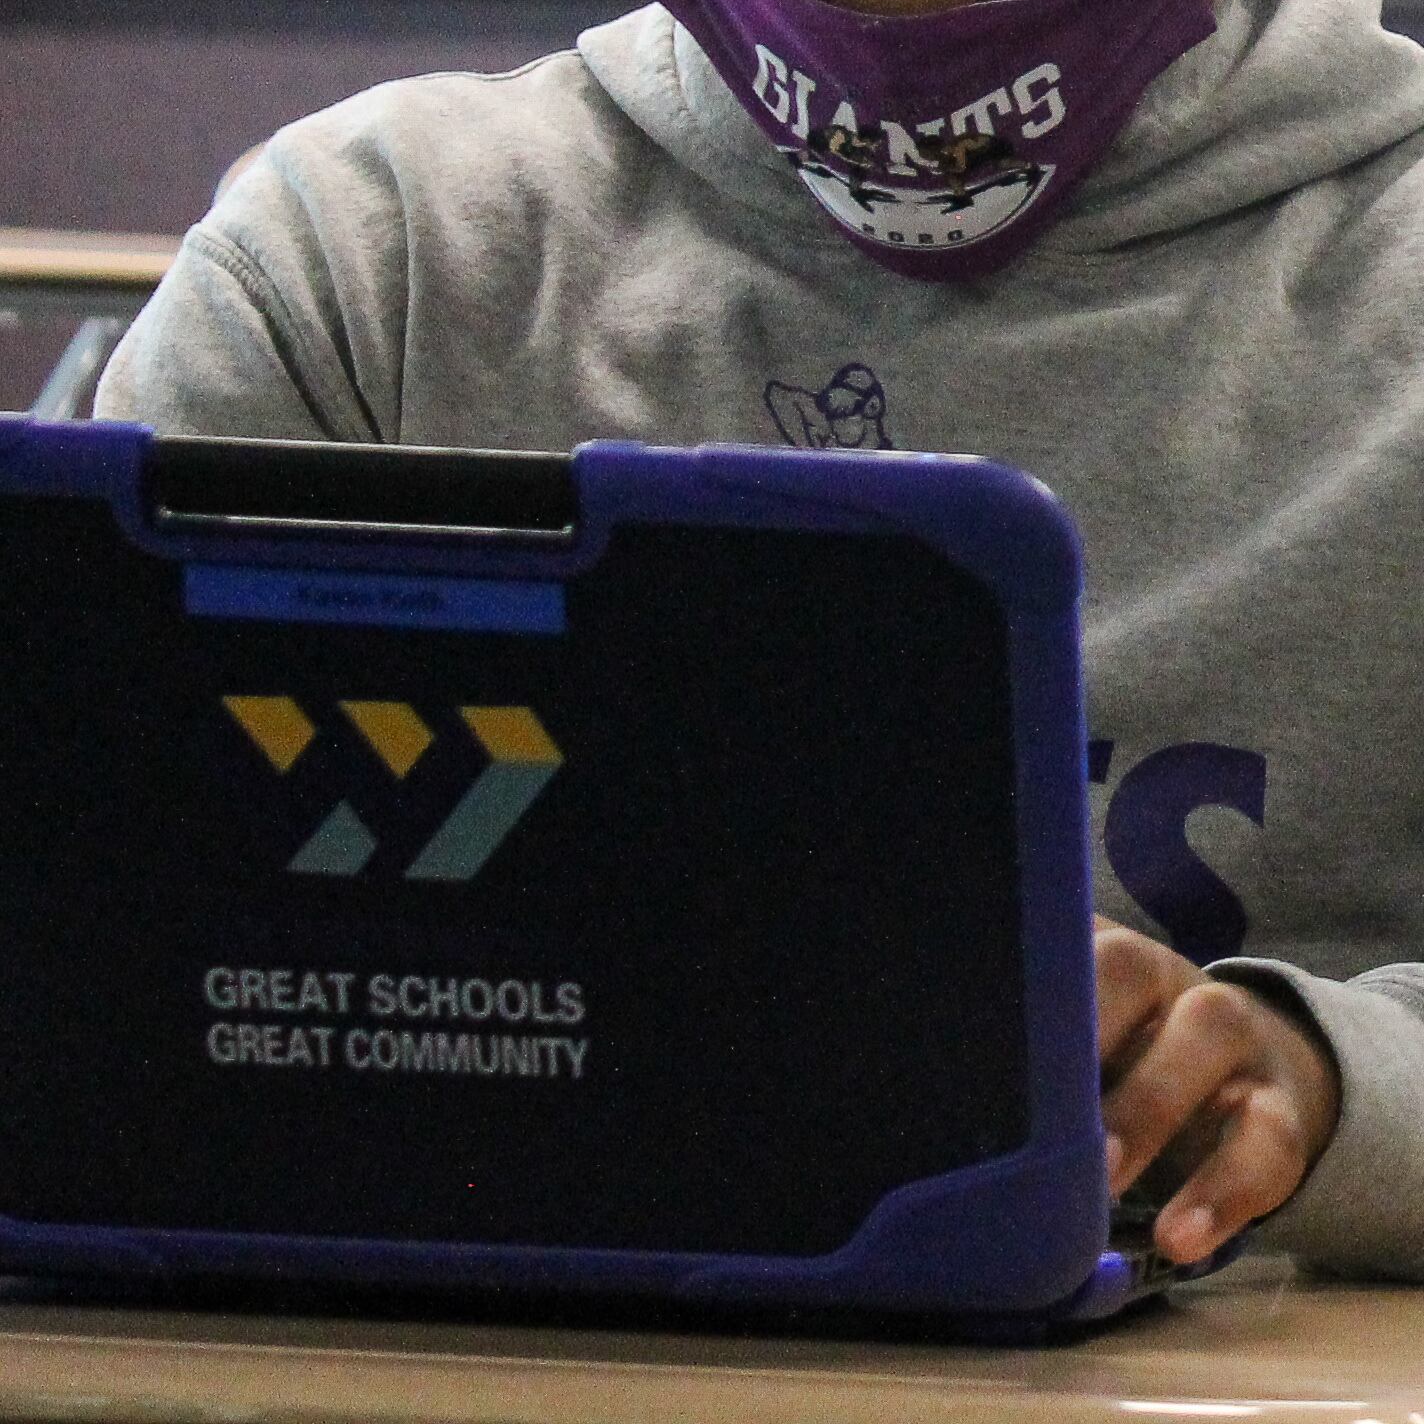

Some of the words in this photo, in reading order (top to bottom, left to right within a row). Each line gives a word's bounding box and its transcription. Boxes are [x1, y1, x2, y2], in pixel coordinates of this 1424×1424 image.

[752, 43, 1068, 177] GIANTS
[204, 967, 355, 1013] GREAT
[367, 974, 587, 1023] SCHOOLS
[206, 1022, 336, 1066] GREAT
[344, 1028, 589, 1078] COMMUNITY
